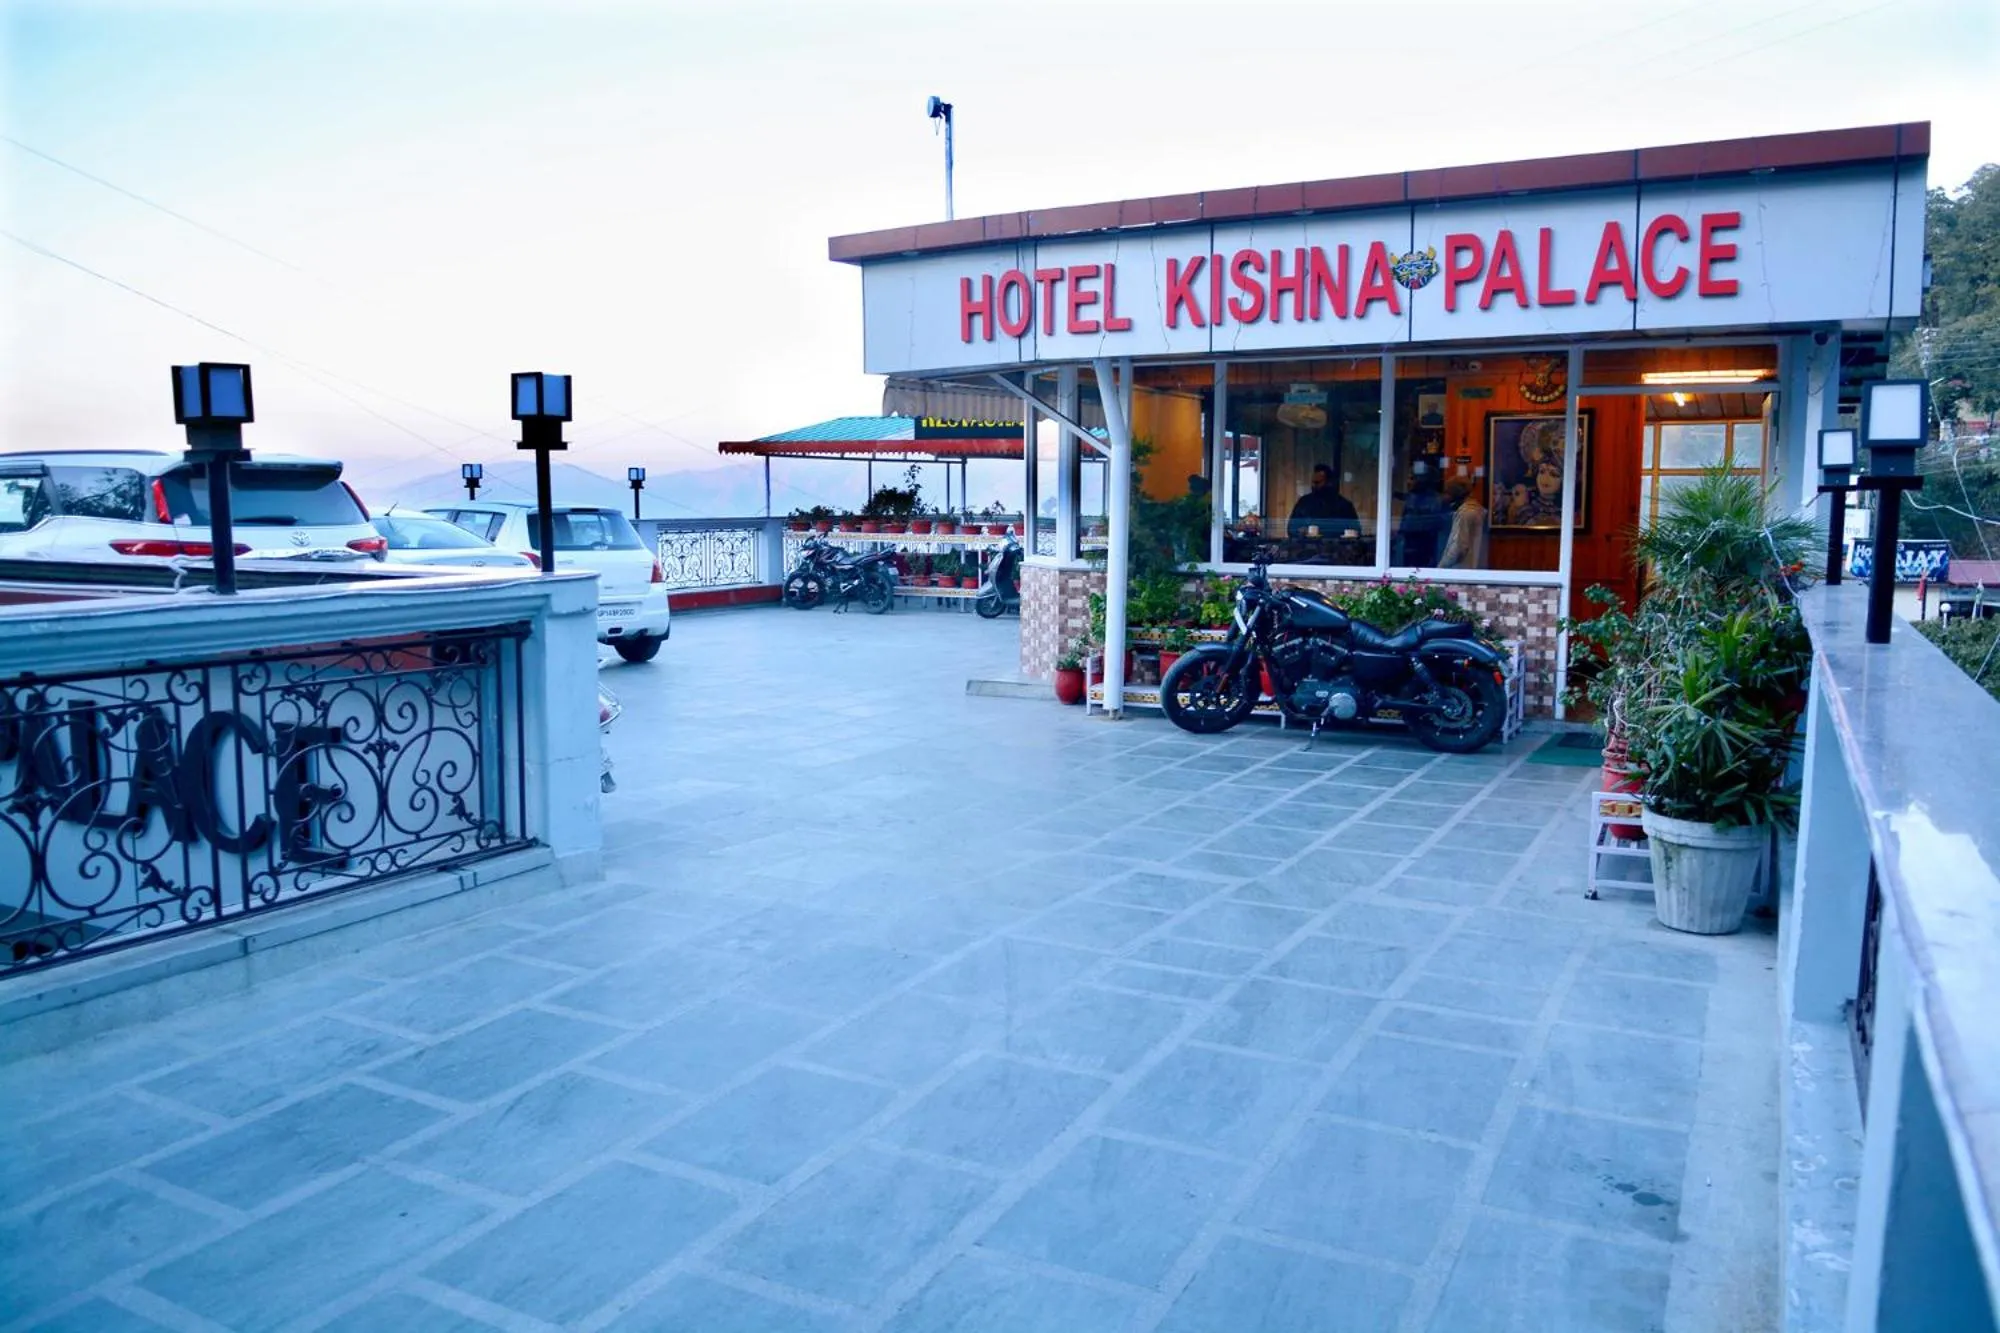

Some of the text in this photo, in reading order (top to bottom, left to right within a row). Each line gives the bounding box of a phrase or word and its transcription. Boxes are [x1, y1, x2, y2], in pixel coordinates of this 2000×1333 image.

[960, 211, 1740, 343] HOTEL KISHNA PALACE
